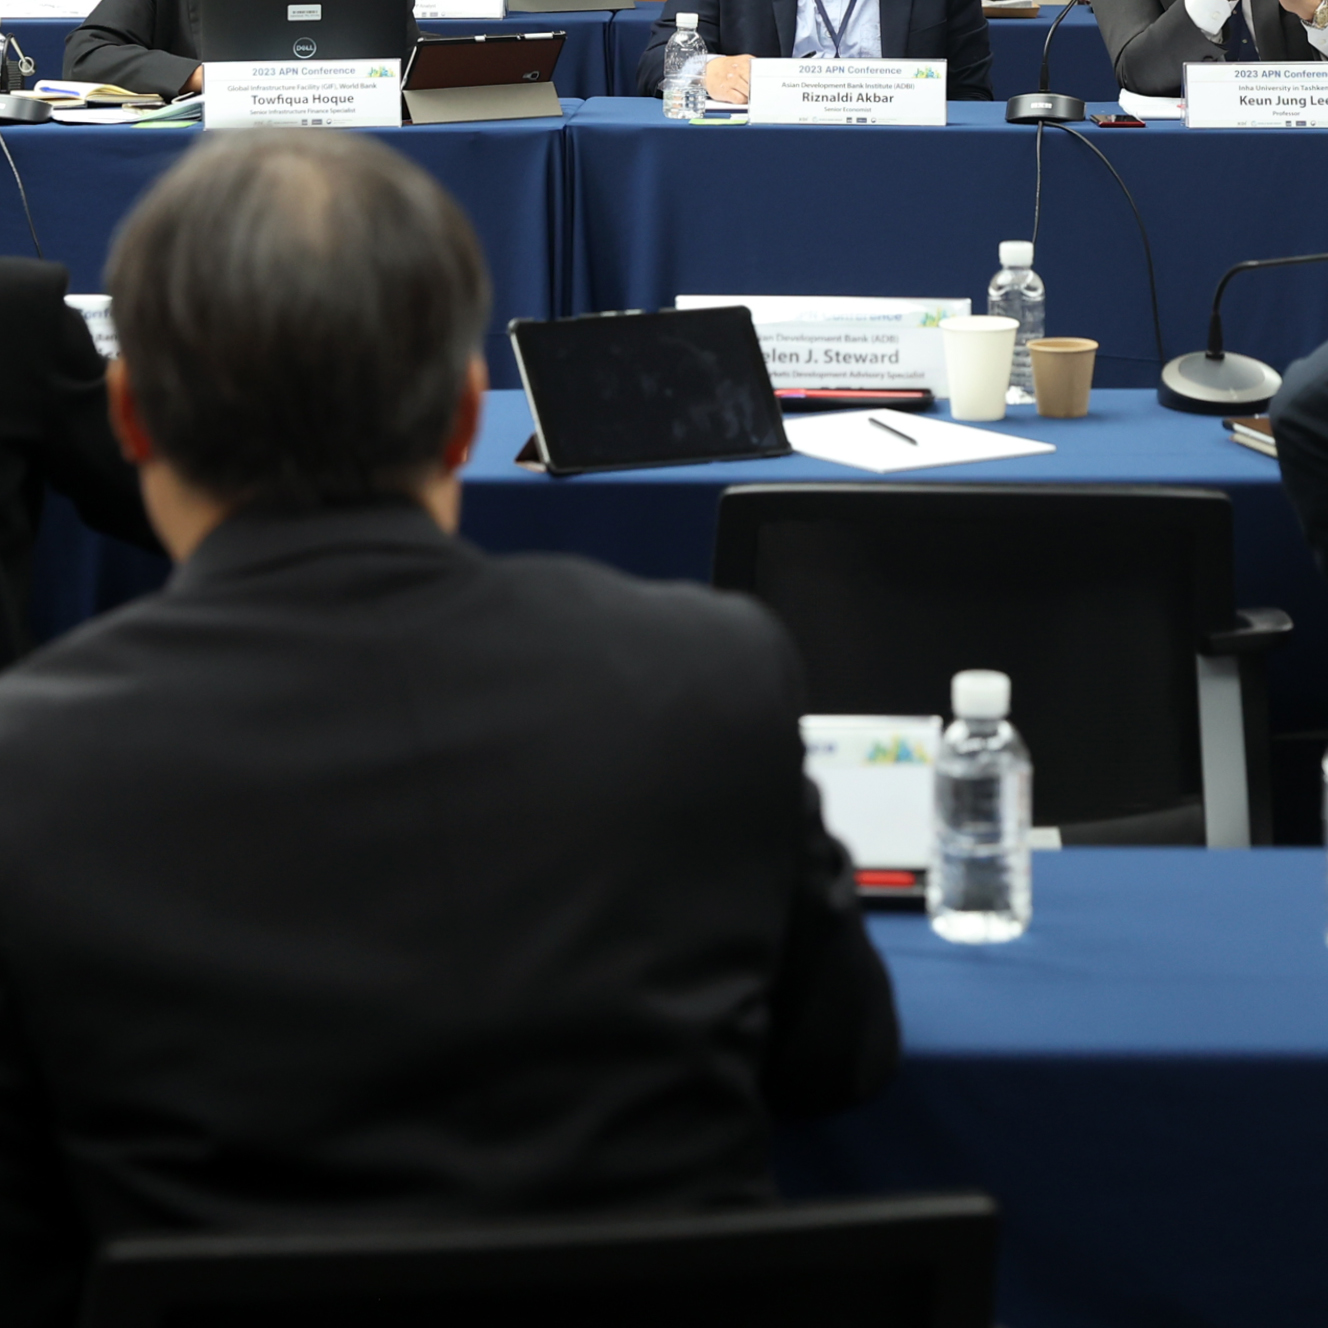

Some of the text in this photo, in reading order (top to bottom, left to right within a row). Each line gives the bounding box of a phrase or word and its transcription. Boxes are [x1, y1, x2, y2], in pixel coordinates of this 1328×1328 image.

[252, 66, 356, 76] 2023 APN Conference
[798, 65, 902, 74] 2023 APN Conference
[1234, 70, 1258, 78] 2023
[1261, 70, 1281, 78] APN
[297, 83, 320, 92] Facility
[360, 82, 377, 90] Bank
[800, 82, 846, 90] Development
[251, 94, 355, 107] Towfiqua Hoque
[802, 92, 894, 103] Riznaldi Akbar
[1239, 95, 1272, 106] Keun
[1275, 95, 1307, 108] Jung
[776, 333, 842, 344] Development
[844, 334, 868, 343] Bank
[871, 334, 899, 344] (ADB)
[763, 349, 899, 364] elen J. Steward
